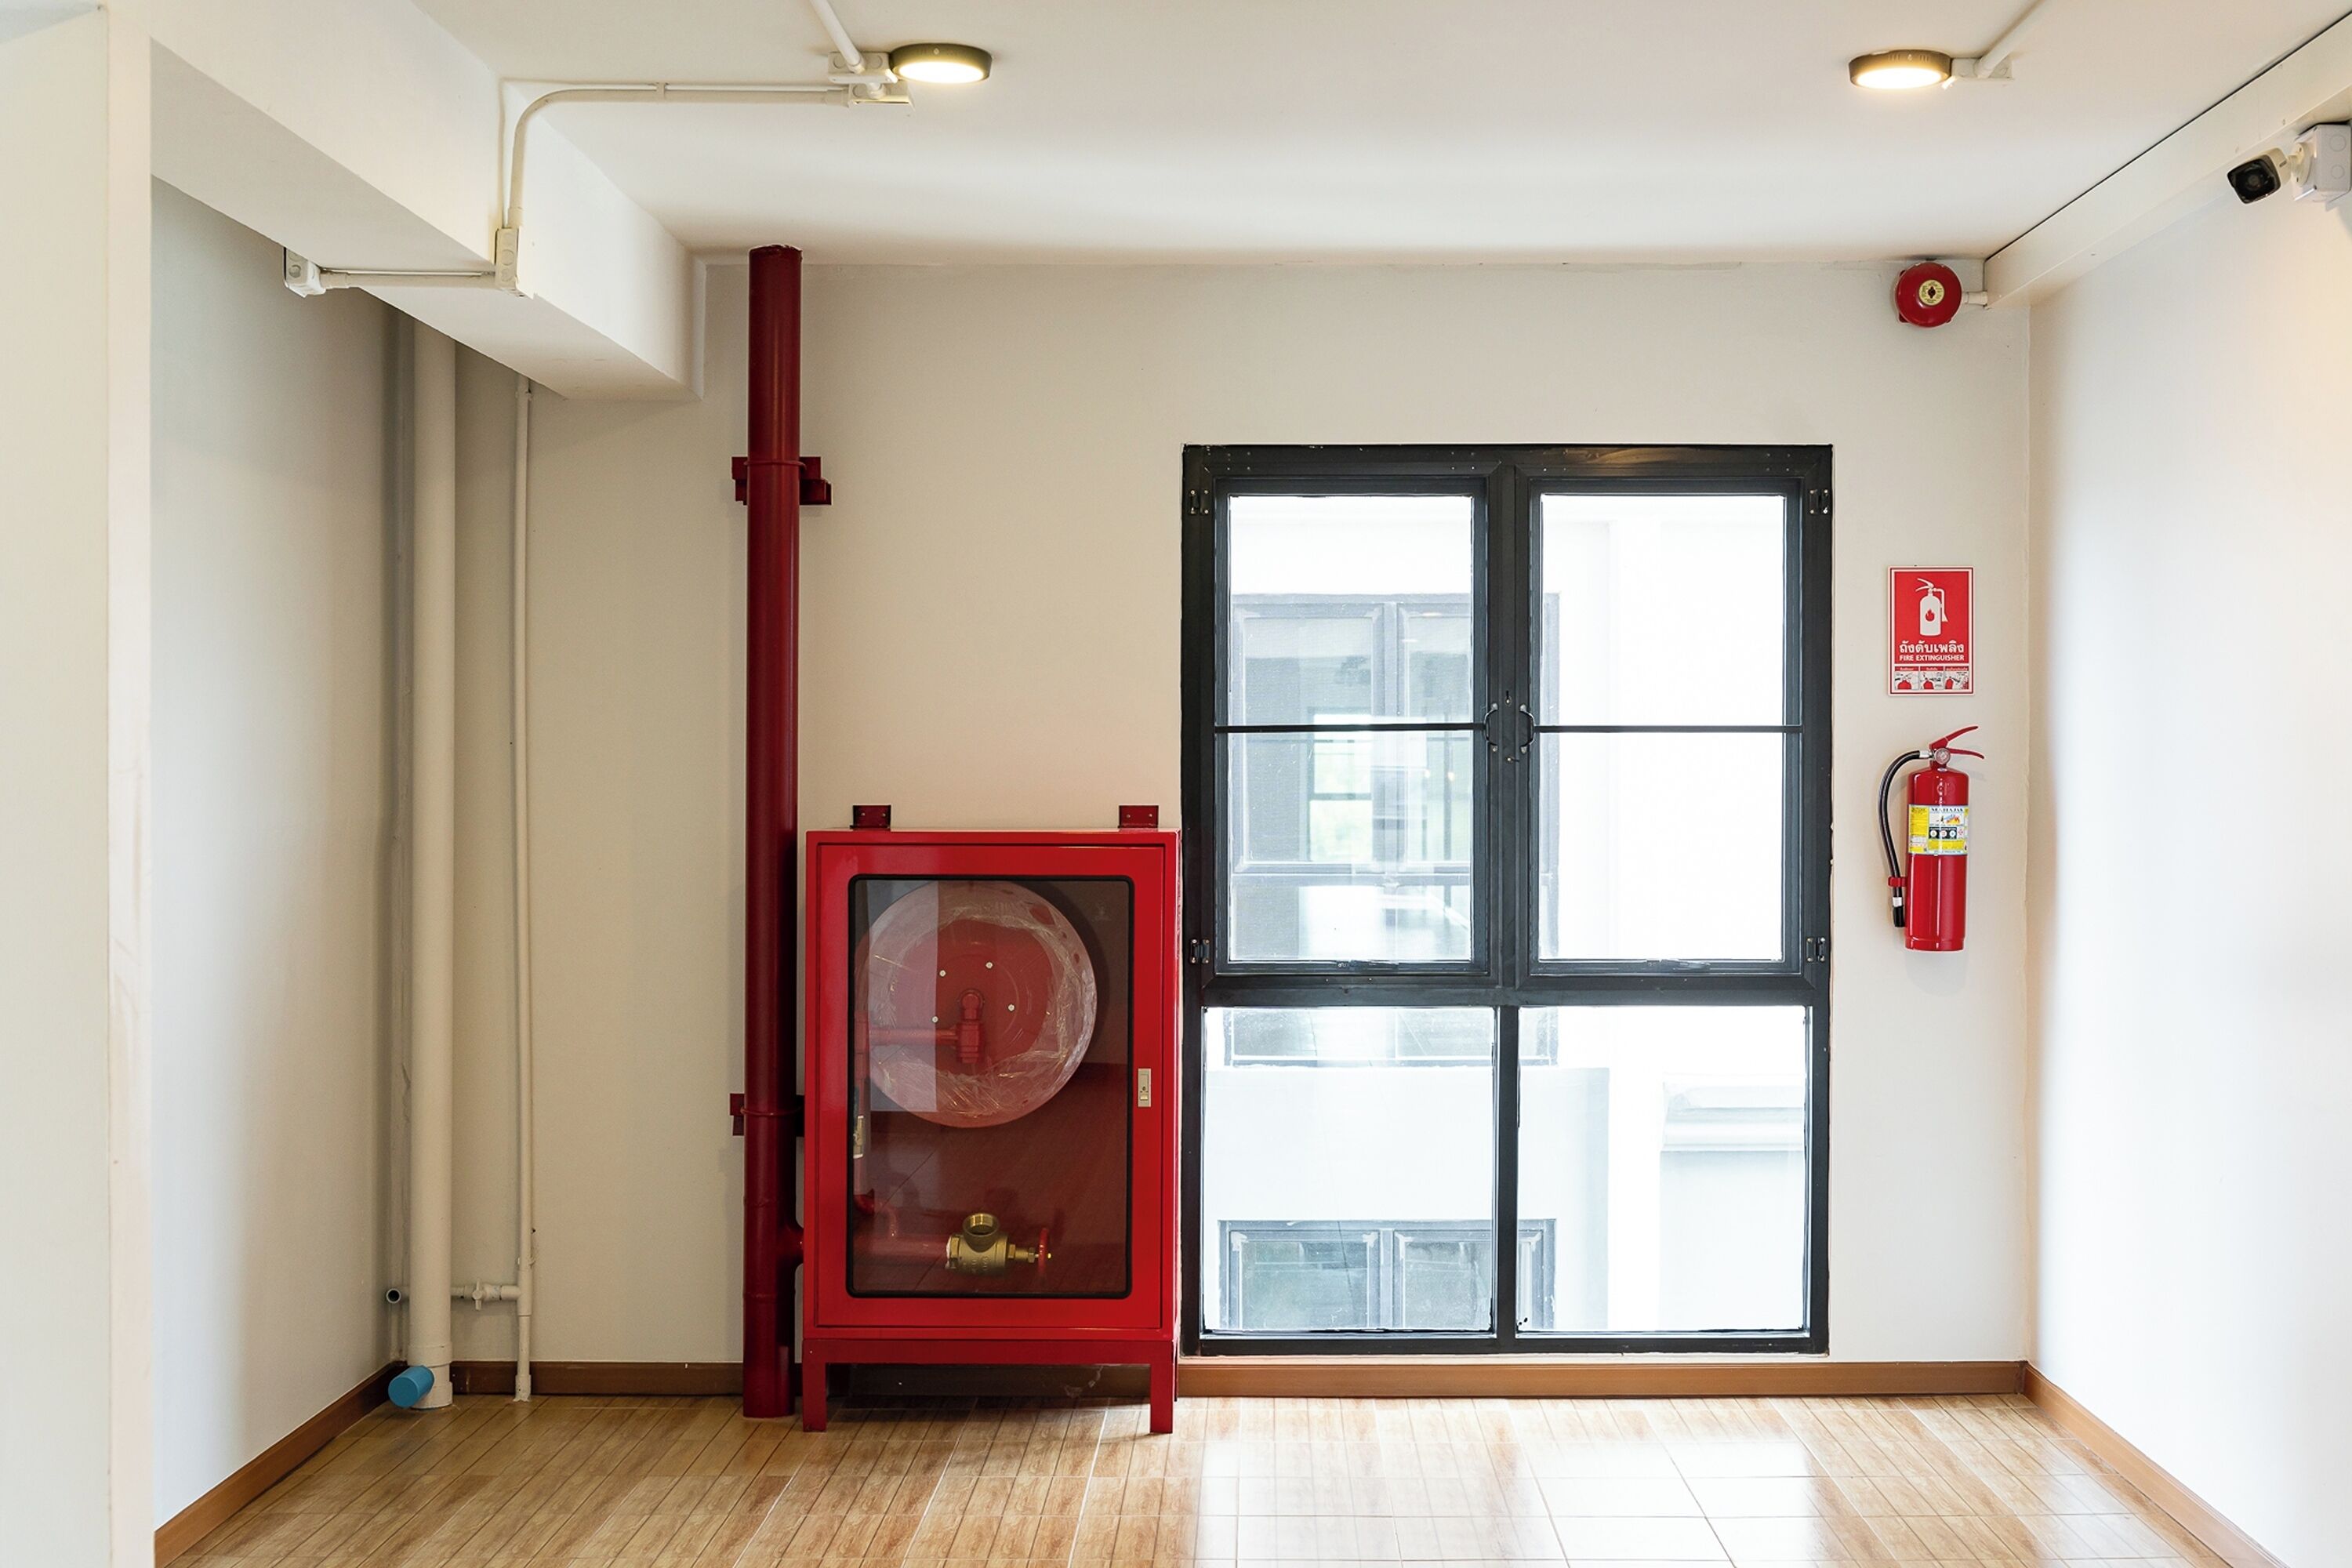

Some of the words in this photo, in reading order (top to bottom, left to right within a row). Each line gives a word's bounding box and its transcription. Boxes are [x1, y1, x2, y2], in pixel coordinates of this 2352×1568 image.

[1900, 640, 1965, 653] ถังดับเพลิง
